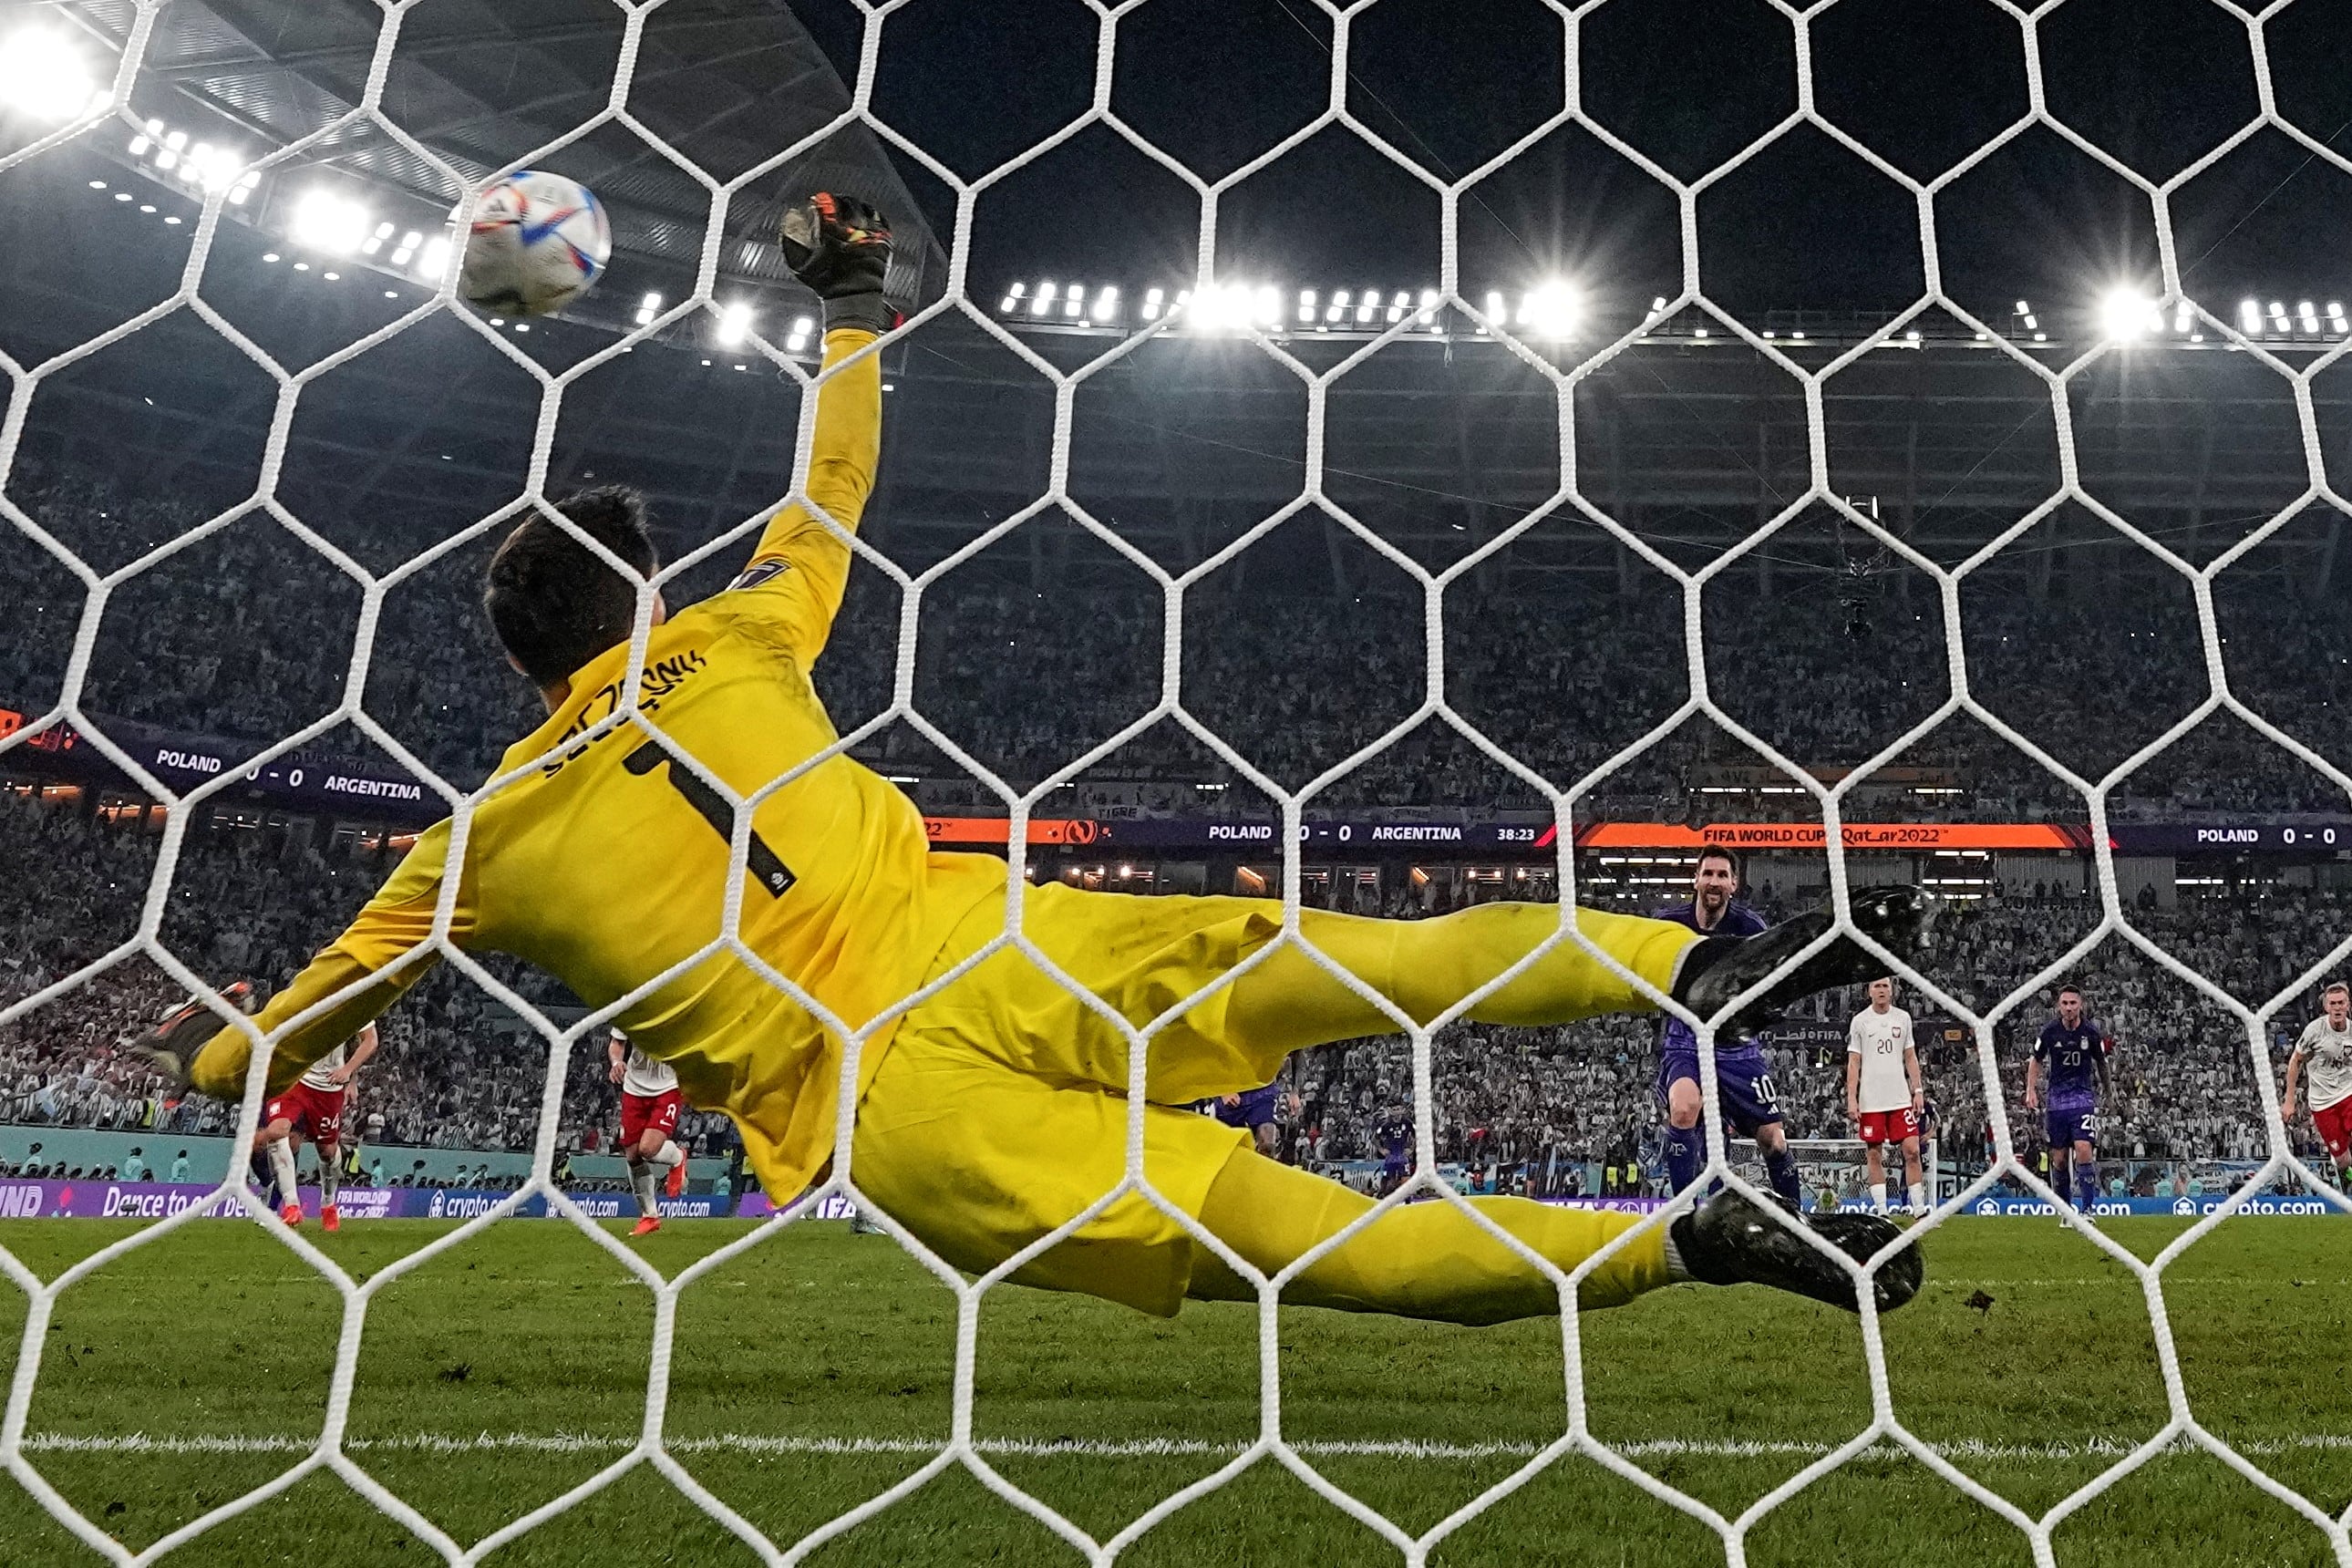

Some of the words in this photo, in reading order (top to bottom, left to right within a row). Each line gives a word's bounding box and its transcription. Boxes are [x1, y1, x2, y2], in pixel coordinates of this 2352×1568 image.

[156, 749, 222, 773] POLAND
[289, 769, 304, 787] 0
[325, 775, 421, 800] ARGENTINA
[622, 739, 798, 900] 1
[1208, 825, 1273, 841] POLAND
[1337, 825, 1352, 841] 0
[1371, 825, 1461, 841] ARGENTINA
[1497, 828, 1535, 841] 38:23
[1704, 830, 1736, 842] FIFA
[1738, 830, 1793, 842] WORLD
[1795, 830, 1826, 842] CUP
[2197, 829, 2259, 842] POLAND
[2283, 828, 2295, 844] 0
[2323, 828, 2336, 844] 0
[1817, 1030, 1841, 1040] FIFA
[1877, 1037, 1893, 1054] 20
[2062, 1050, 2081, 1067] 20
[1750, 1074, 1777, 1104] 10
[319, 1112, 340, 1133] 24
[166, 1189, 188, 1217] to
